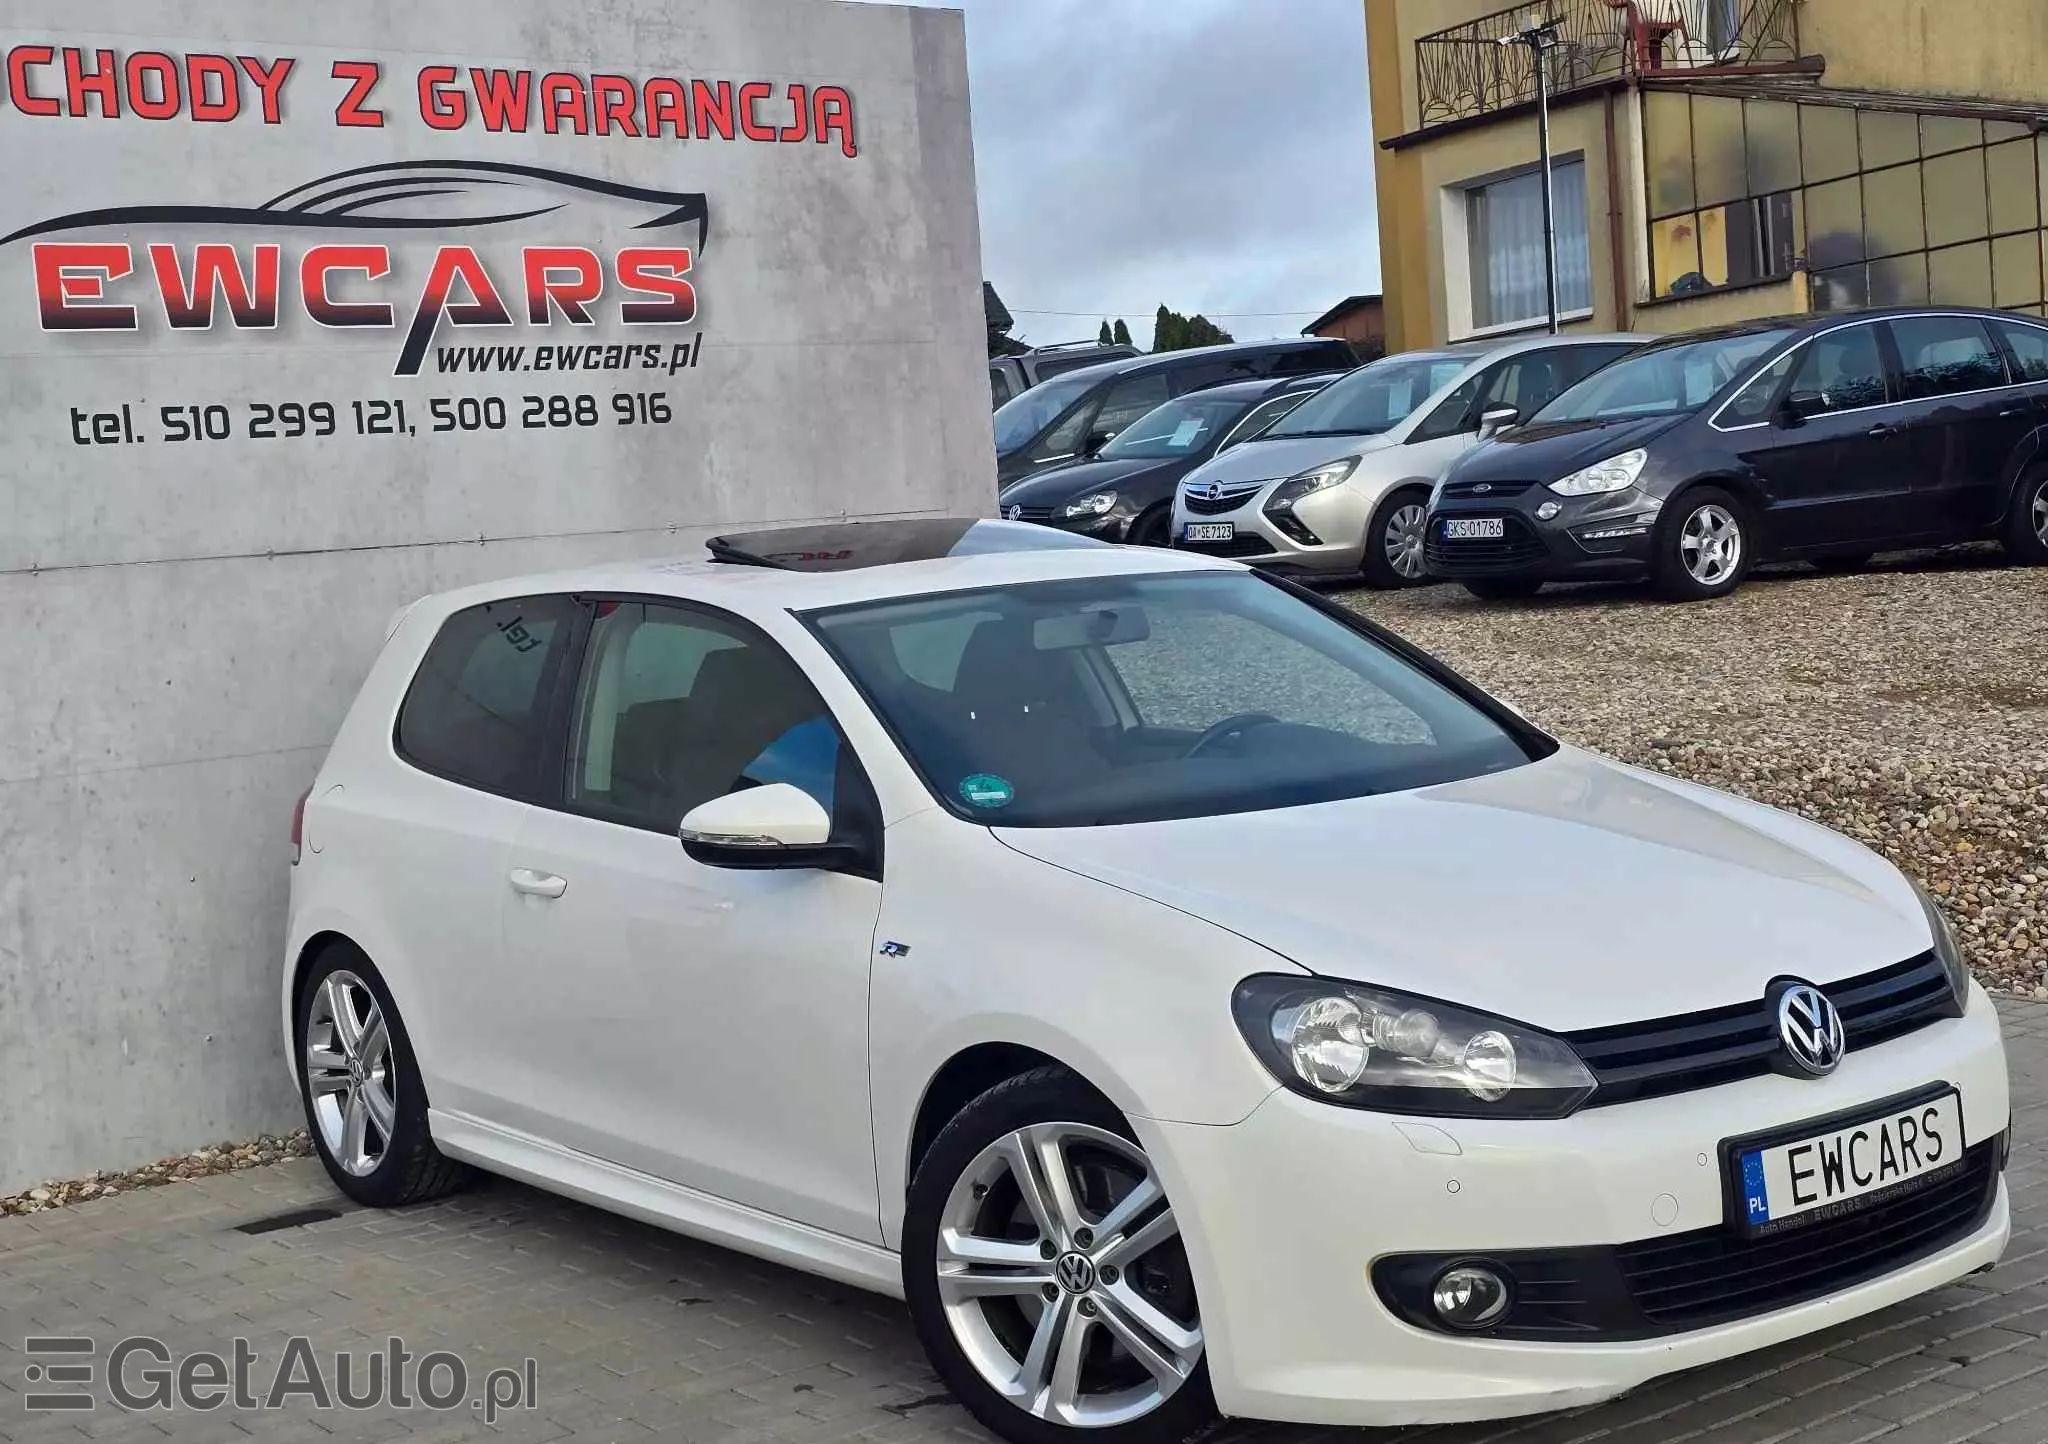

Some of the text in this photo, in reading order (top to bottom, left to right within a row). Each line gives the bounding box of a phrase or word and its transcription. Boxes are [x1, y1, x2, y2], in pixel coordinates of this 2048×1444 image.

[331, 60, 384, 127] Z
[417, 65, 858, 158] GWARANCJĄ
[32, 242, 698, 377] EWCARS
[437, 332, 703, 376] www.ewcars.pl
[71, 392, 672, 445] tel. 510 299 121, 500 288 916
[1749, 1196, 1767, 1214] PL
[1787, 1107, 1943, 1206] EWCARS
